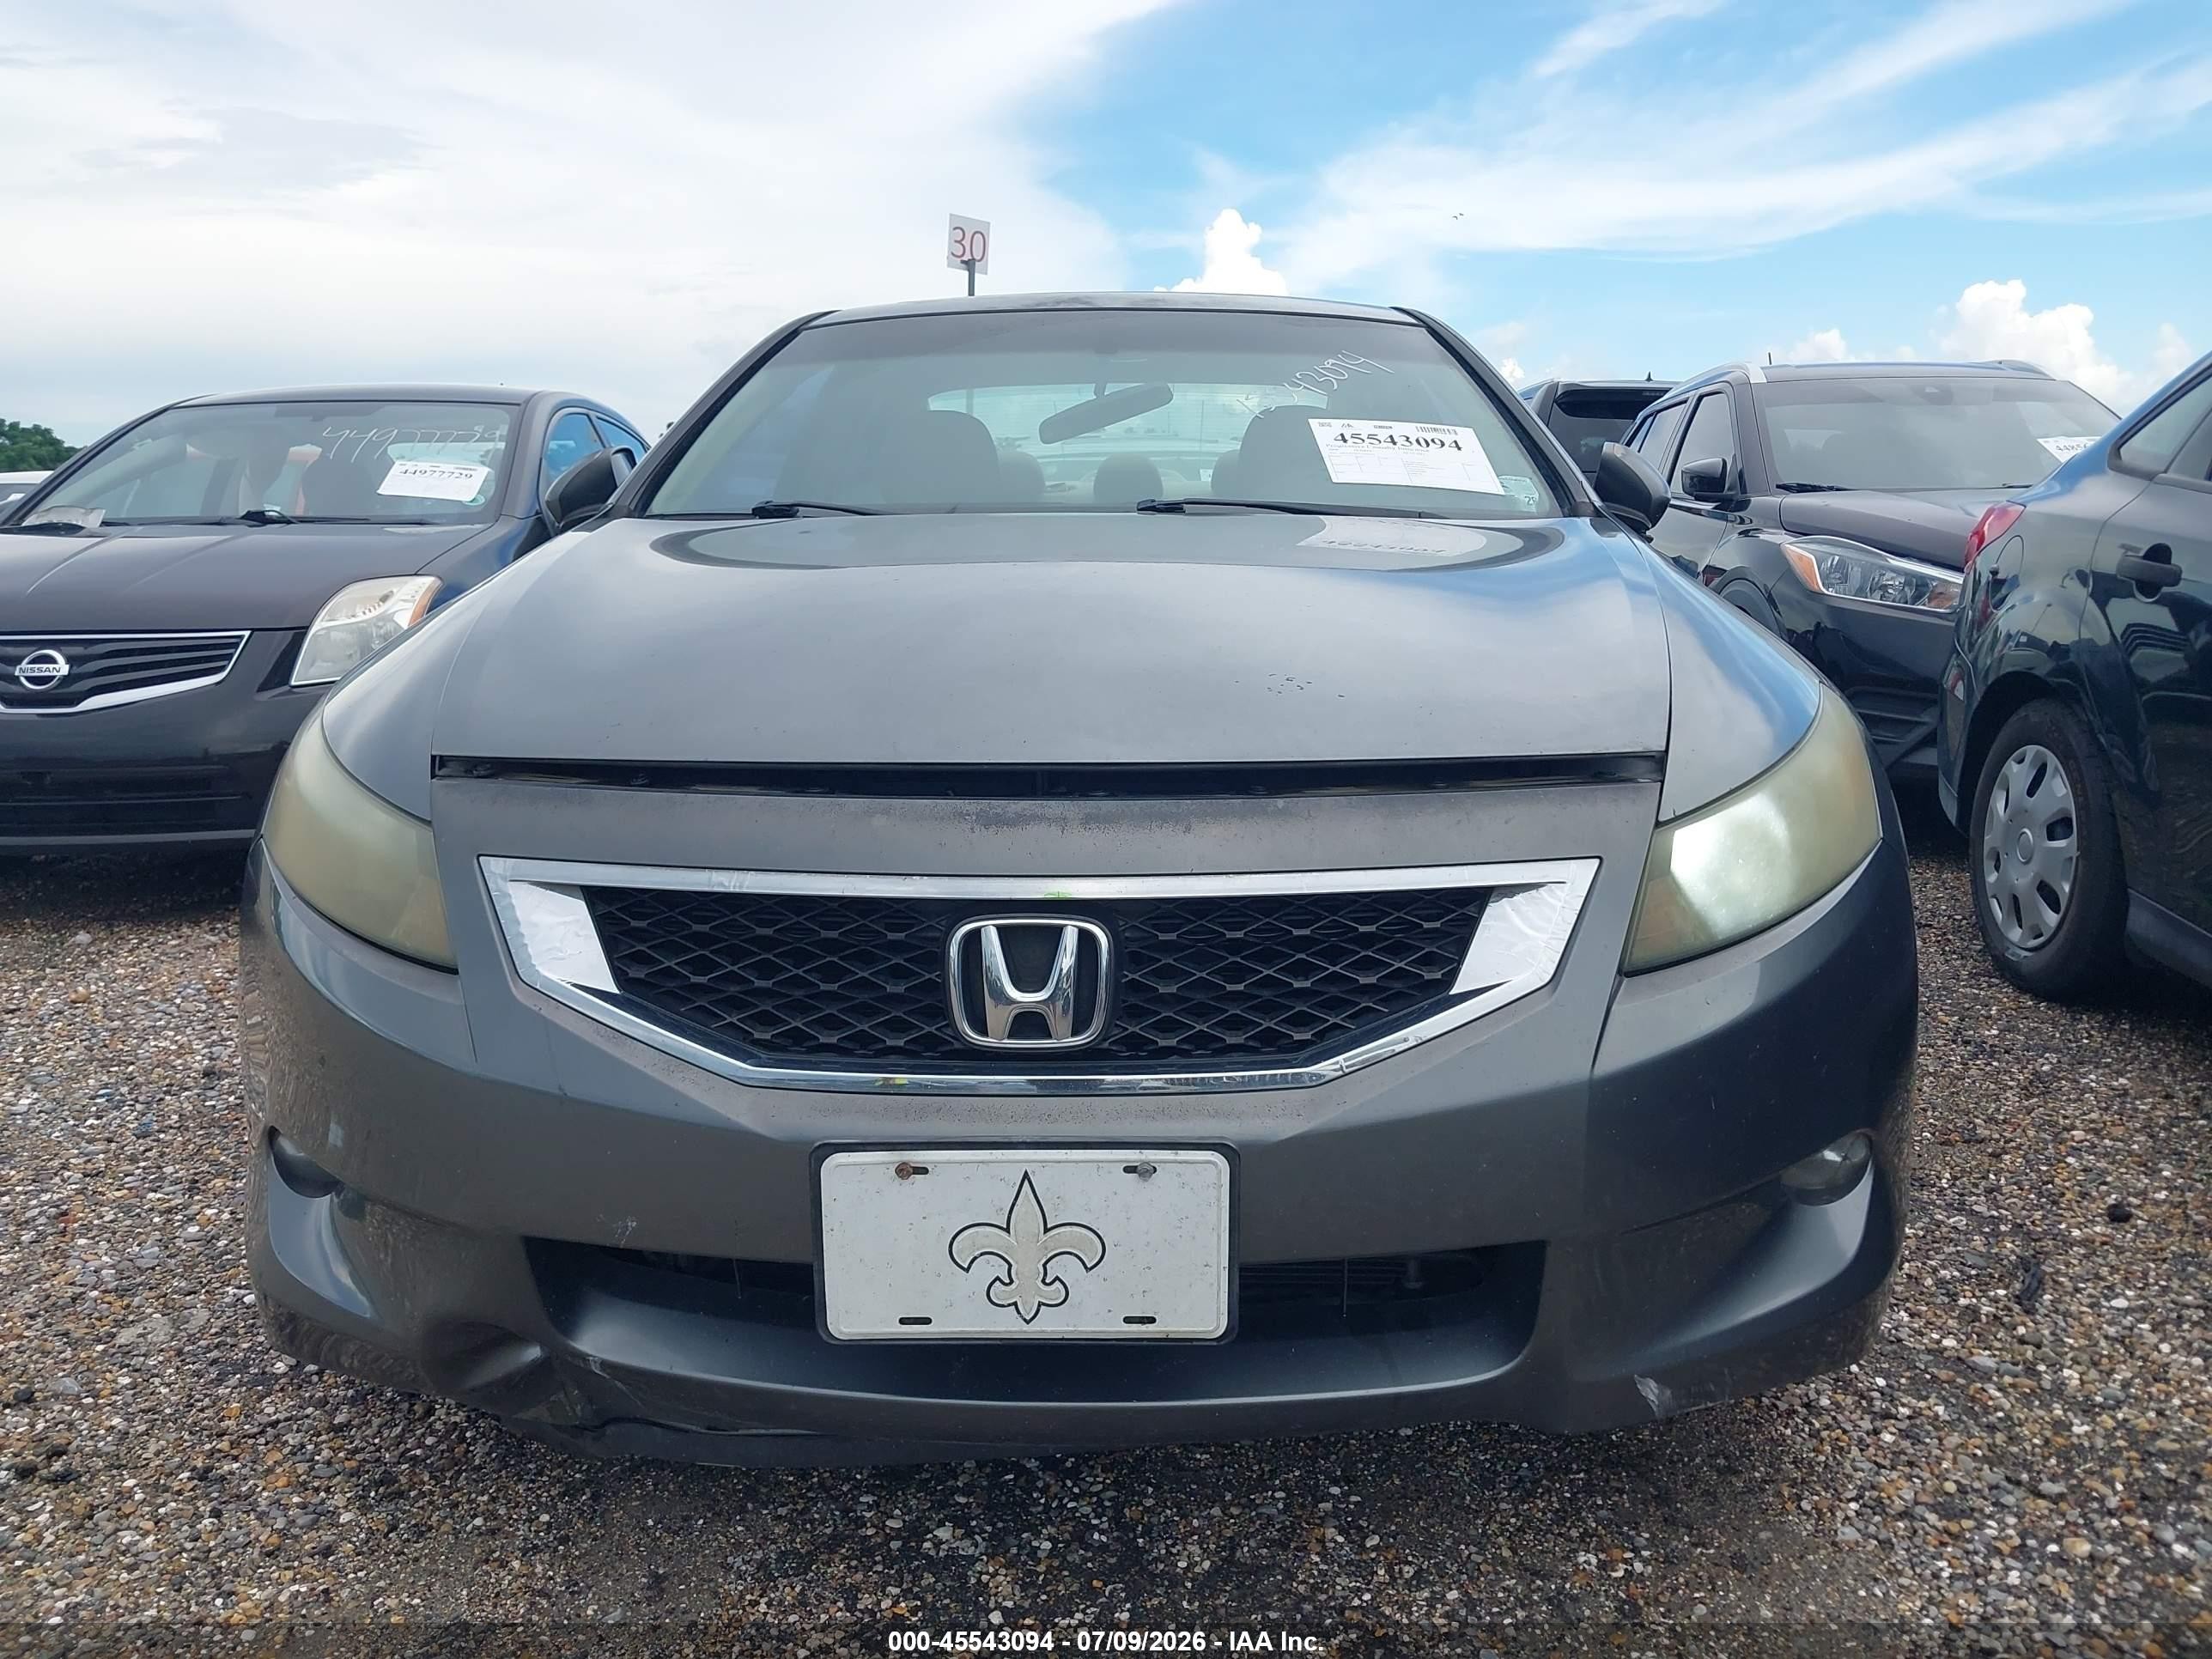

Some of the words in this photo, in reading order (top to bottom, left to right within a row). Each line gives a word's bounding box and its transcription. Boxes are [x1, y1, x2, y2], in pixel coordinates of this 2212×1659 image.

[951, 226, 987, 263] 30
[1333, 432, 1463, 452] 45543094
[398, 468, 474, 480] 44977729
